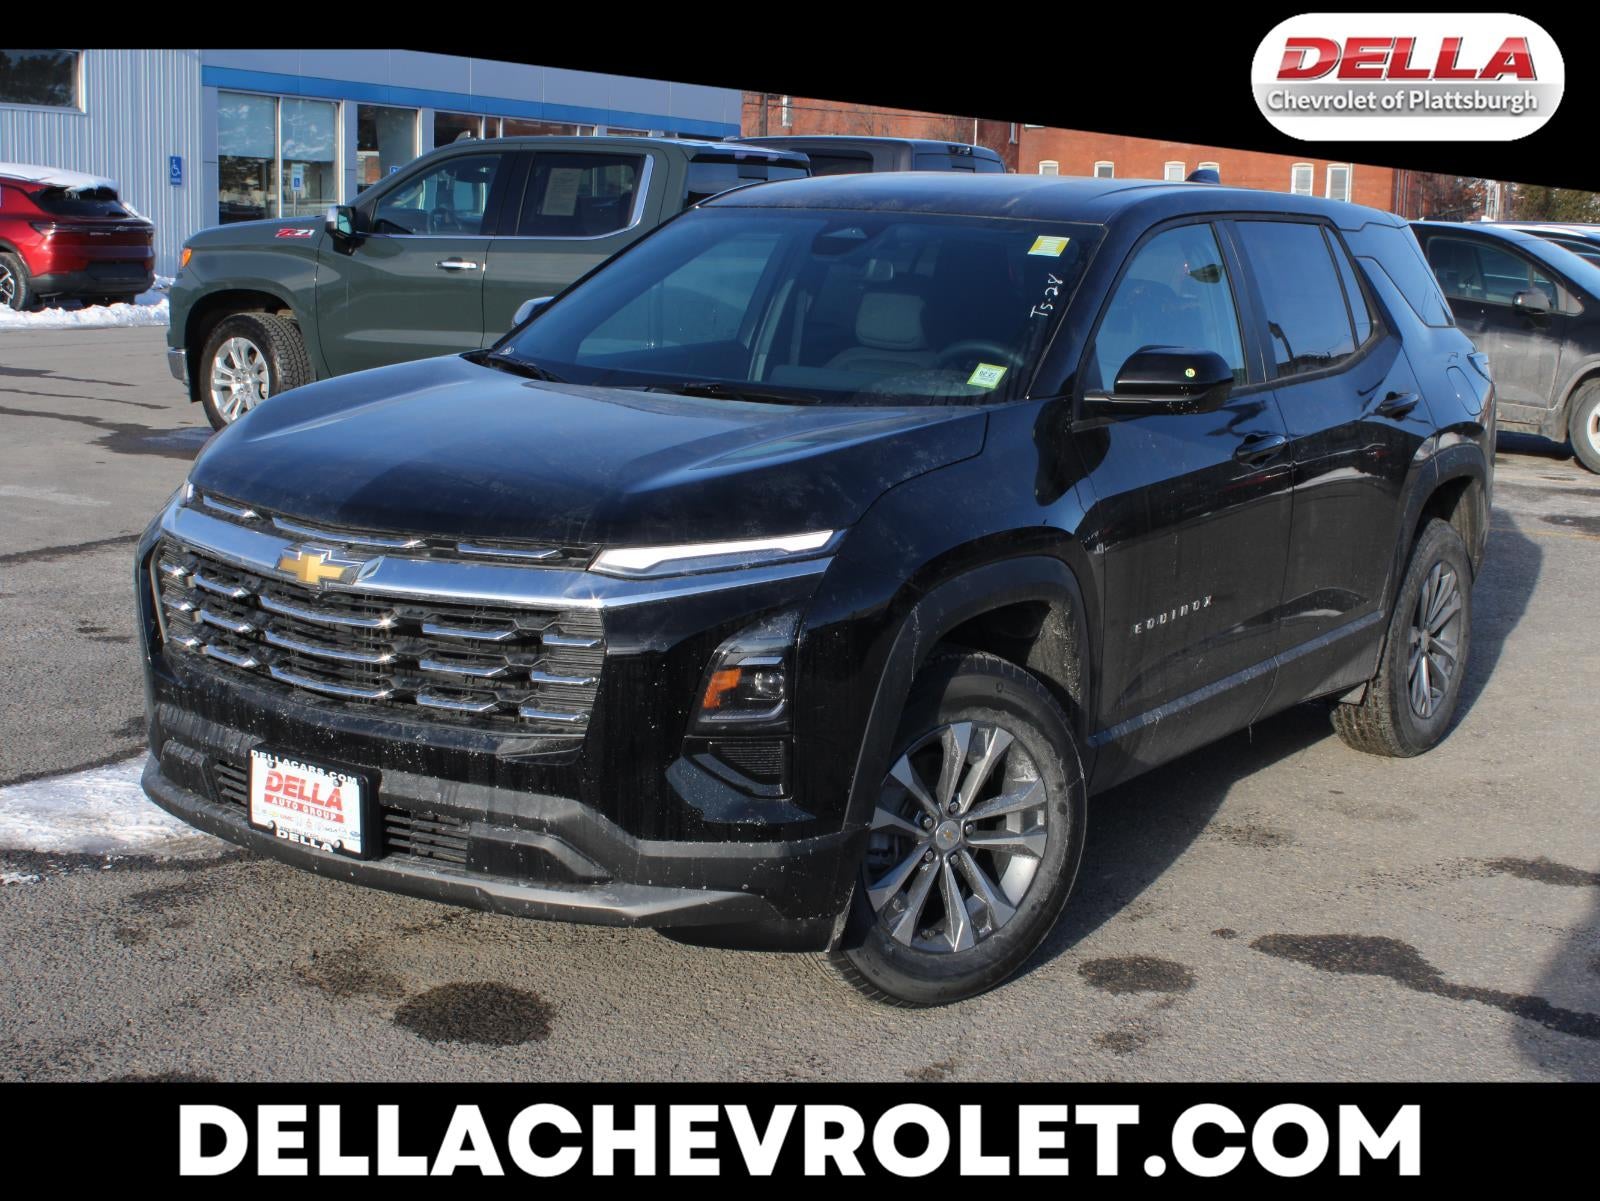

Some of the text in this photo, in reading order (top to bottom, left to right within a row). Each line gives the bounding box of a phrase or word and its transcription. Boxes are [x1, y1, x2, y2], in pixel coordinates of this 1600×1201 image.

[275, 228, 315, 238] Z71
[1134, 595, 1212, 634] EQUINOX
[251, 750, 358, 786] DELLACARS.COM
[265, 770, 343, 811] DELLA
[272, 796, 337, 820] AUTO GROUP
[276, 829, 334, 853] DELLA
